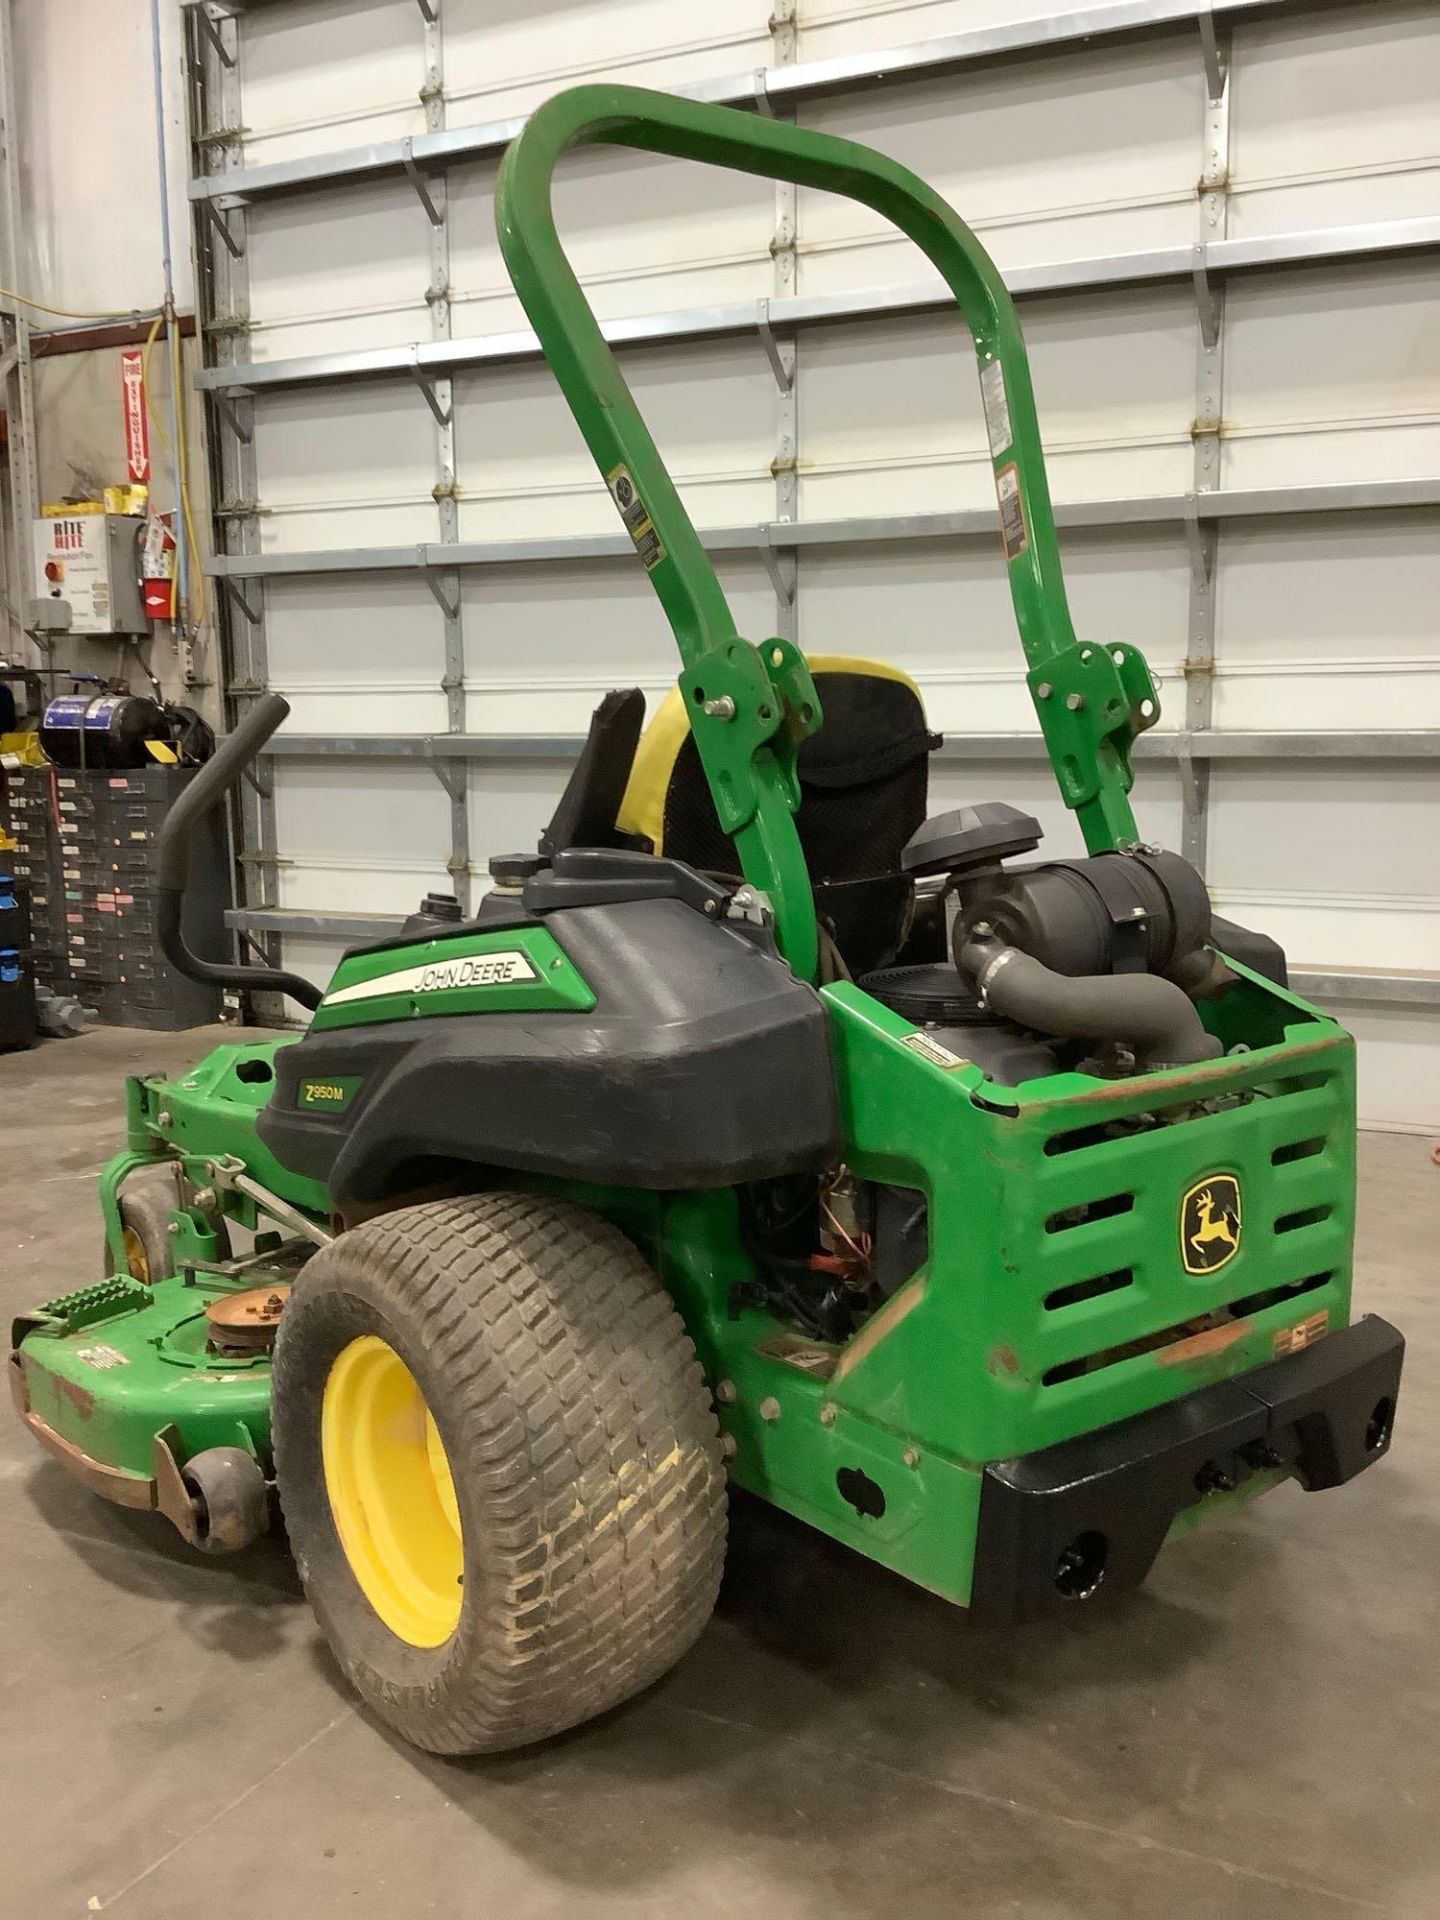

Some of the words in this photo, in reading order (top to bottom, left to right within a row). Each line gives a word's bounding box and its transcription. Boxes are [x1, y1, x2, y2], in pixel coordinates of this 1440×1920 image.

[126, 363, 141, 376] FIRE
[131, 380, 142, 472] EXTINGUISHER
[53, 520, 84, 535] RITE
[54, 535, 84, 550] HITE
[414, 966, 458, 988] JOHN
[459, 960, 517, 982] DEERE
[305, 1084, 344, 1102] Z950M
